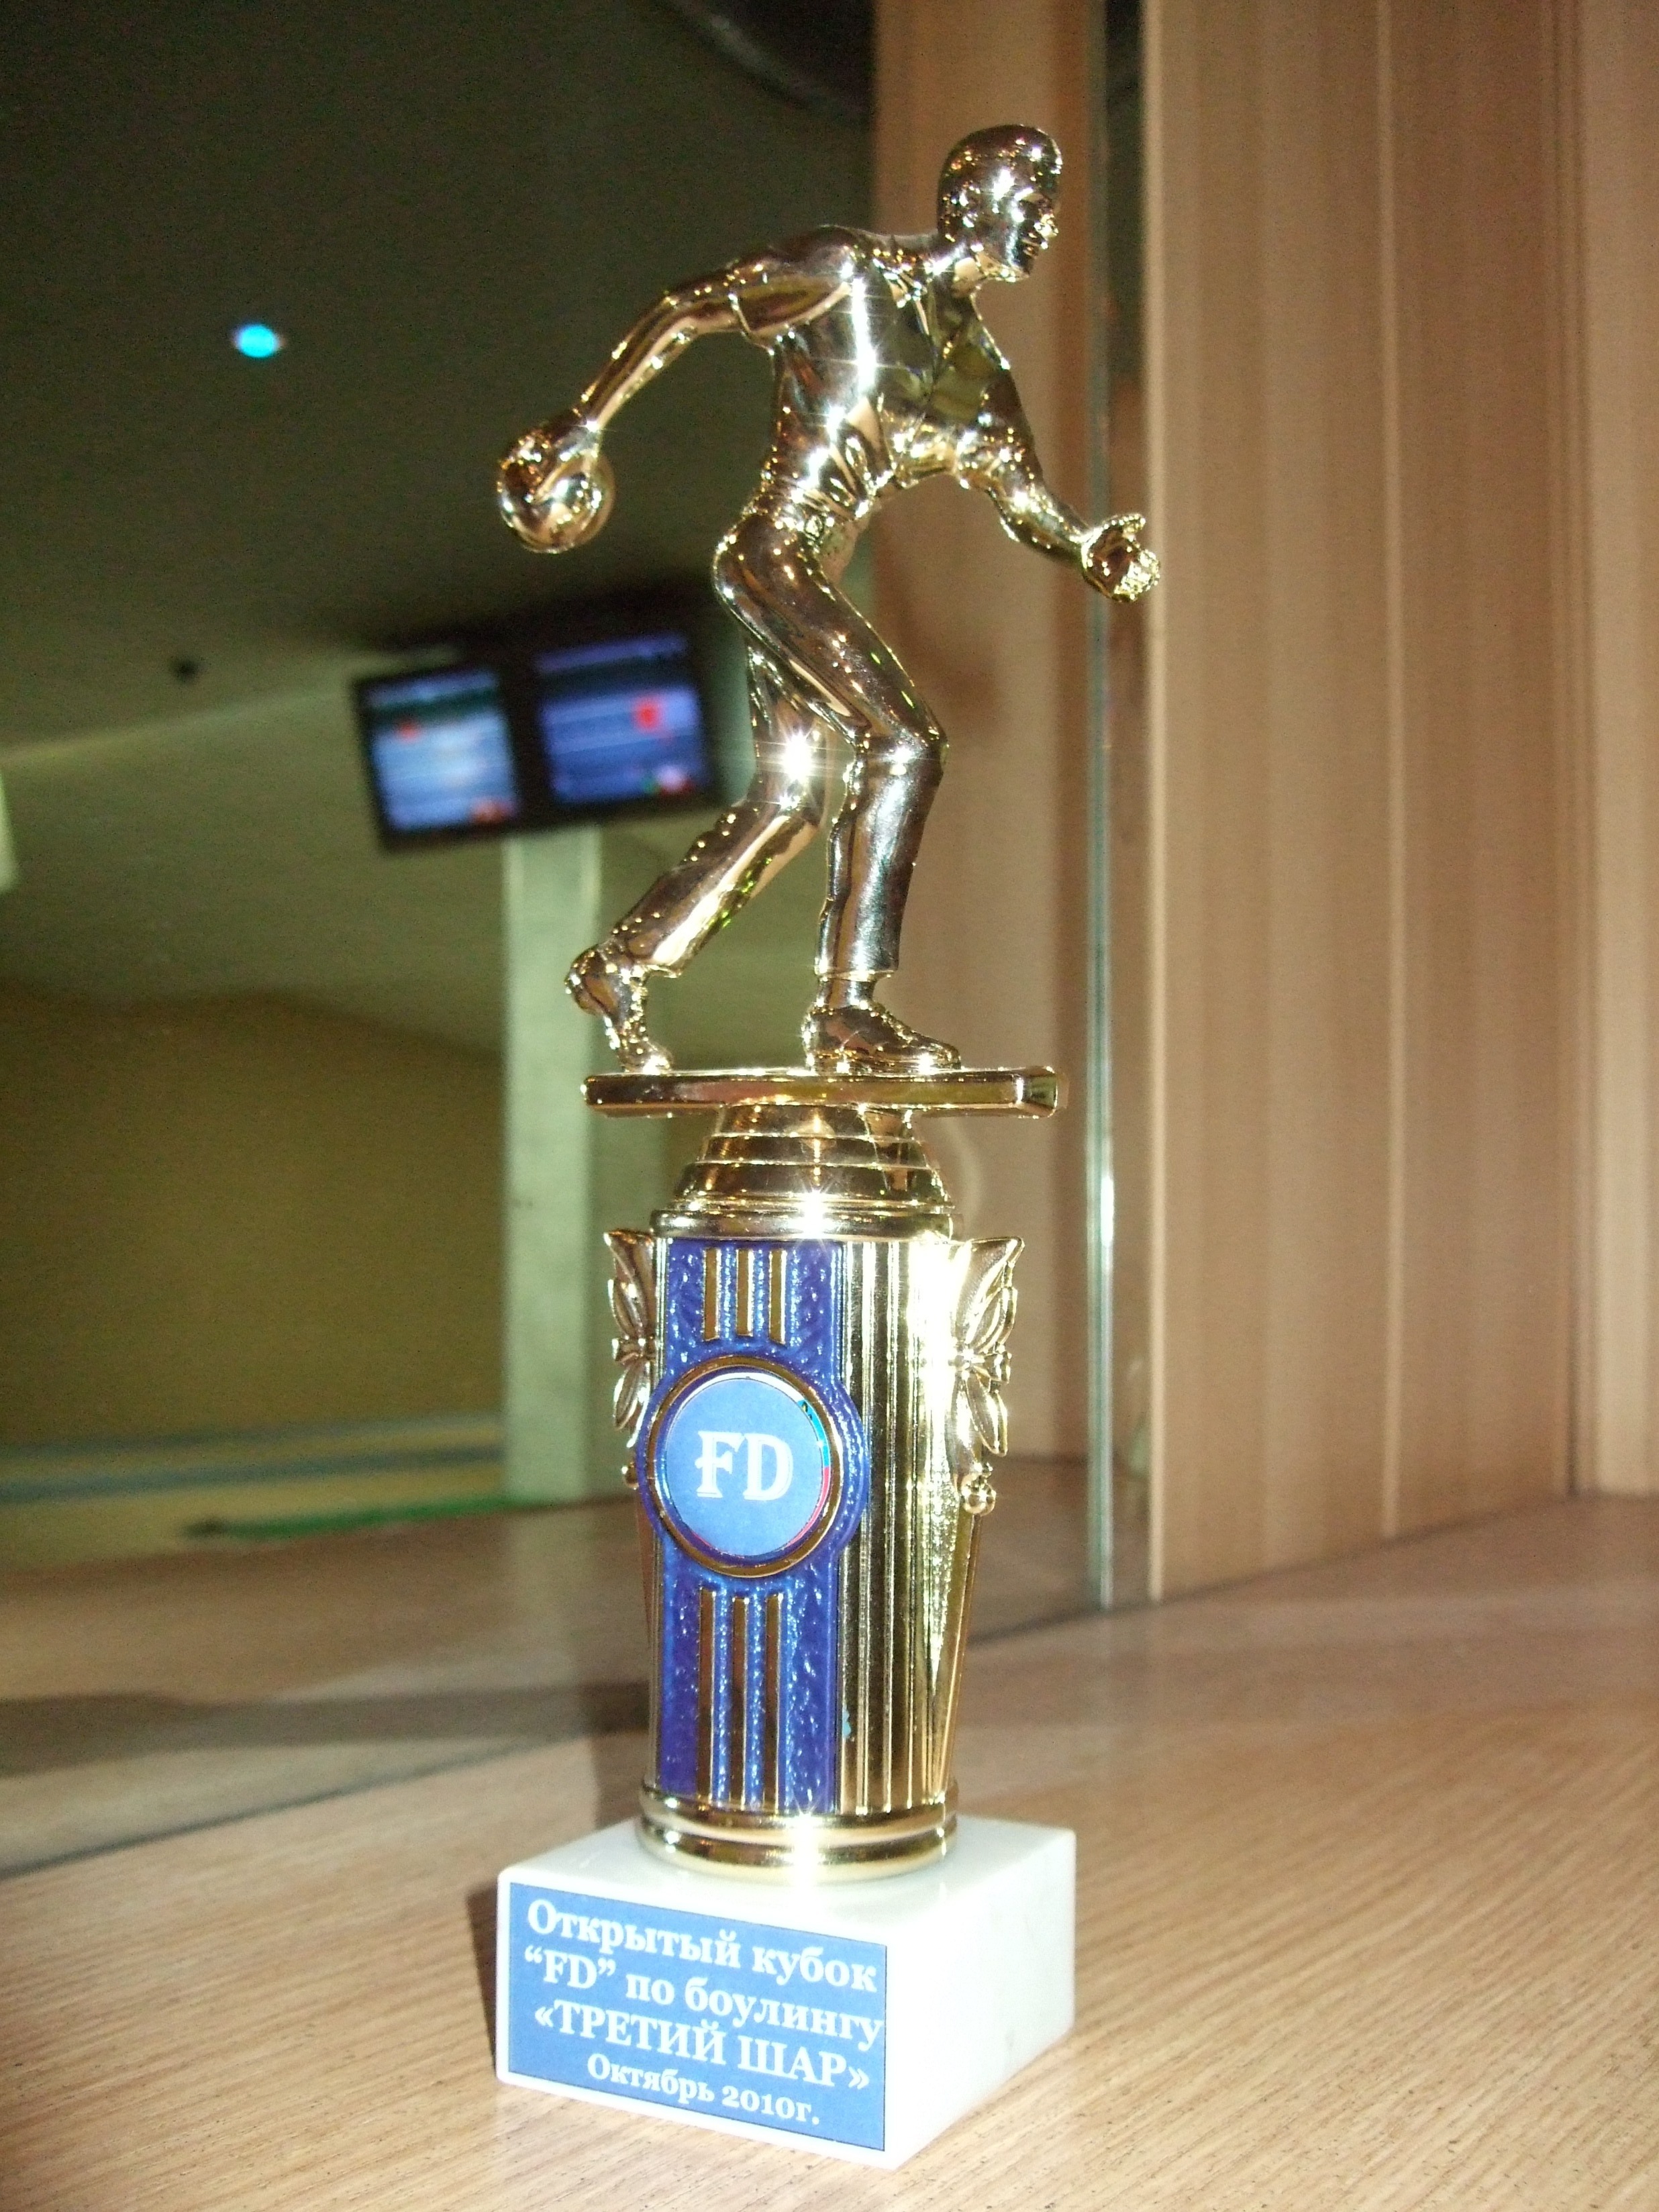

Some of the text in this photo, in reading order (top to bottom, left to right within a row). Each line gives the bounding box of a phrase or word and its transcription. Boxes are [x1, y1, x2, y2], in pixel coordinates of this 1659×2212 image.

[695, 1430, 793, 1501] FD
[527, 1899, 878, 1993] Открытый кубок
[534, 1999, 870, 2091] «ТРЕТИЙ ШАР»
[625, 1974, 673, 2005] по
[684, 1977, 885, 2052] боулингу
[587, 2053, 819, 2125] Октябрь 2010г.
